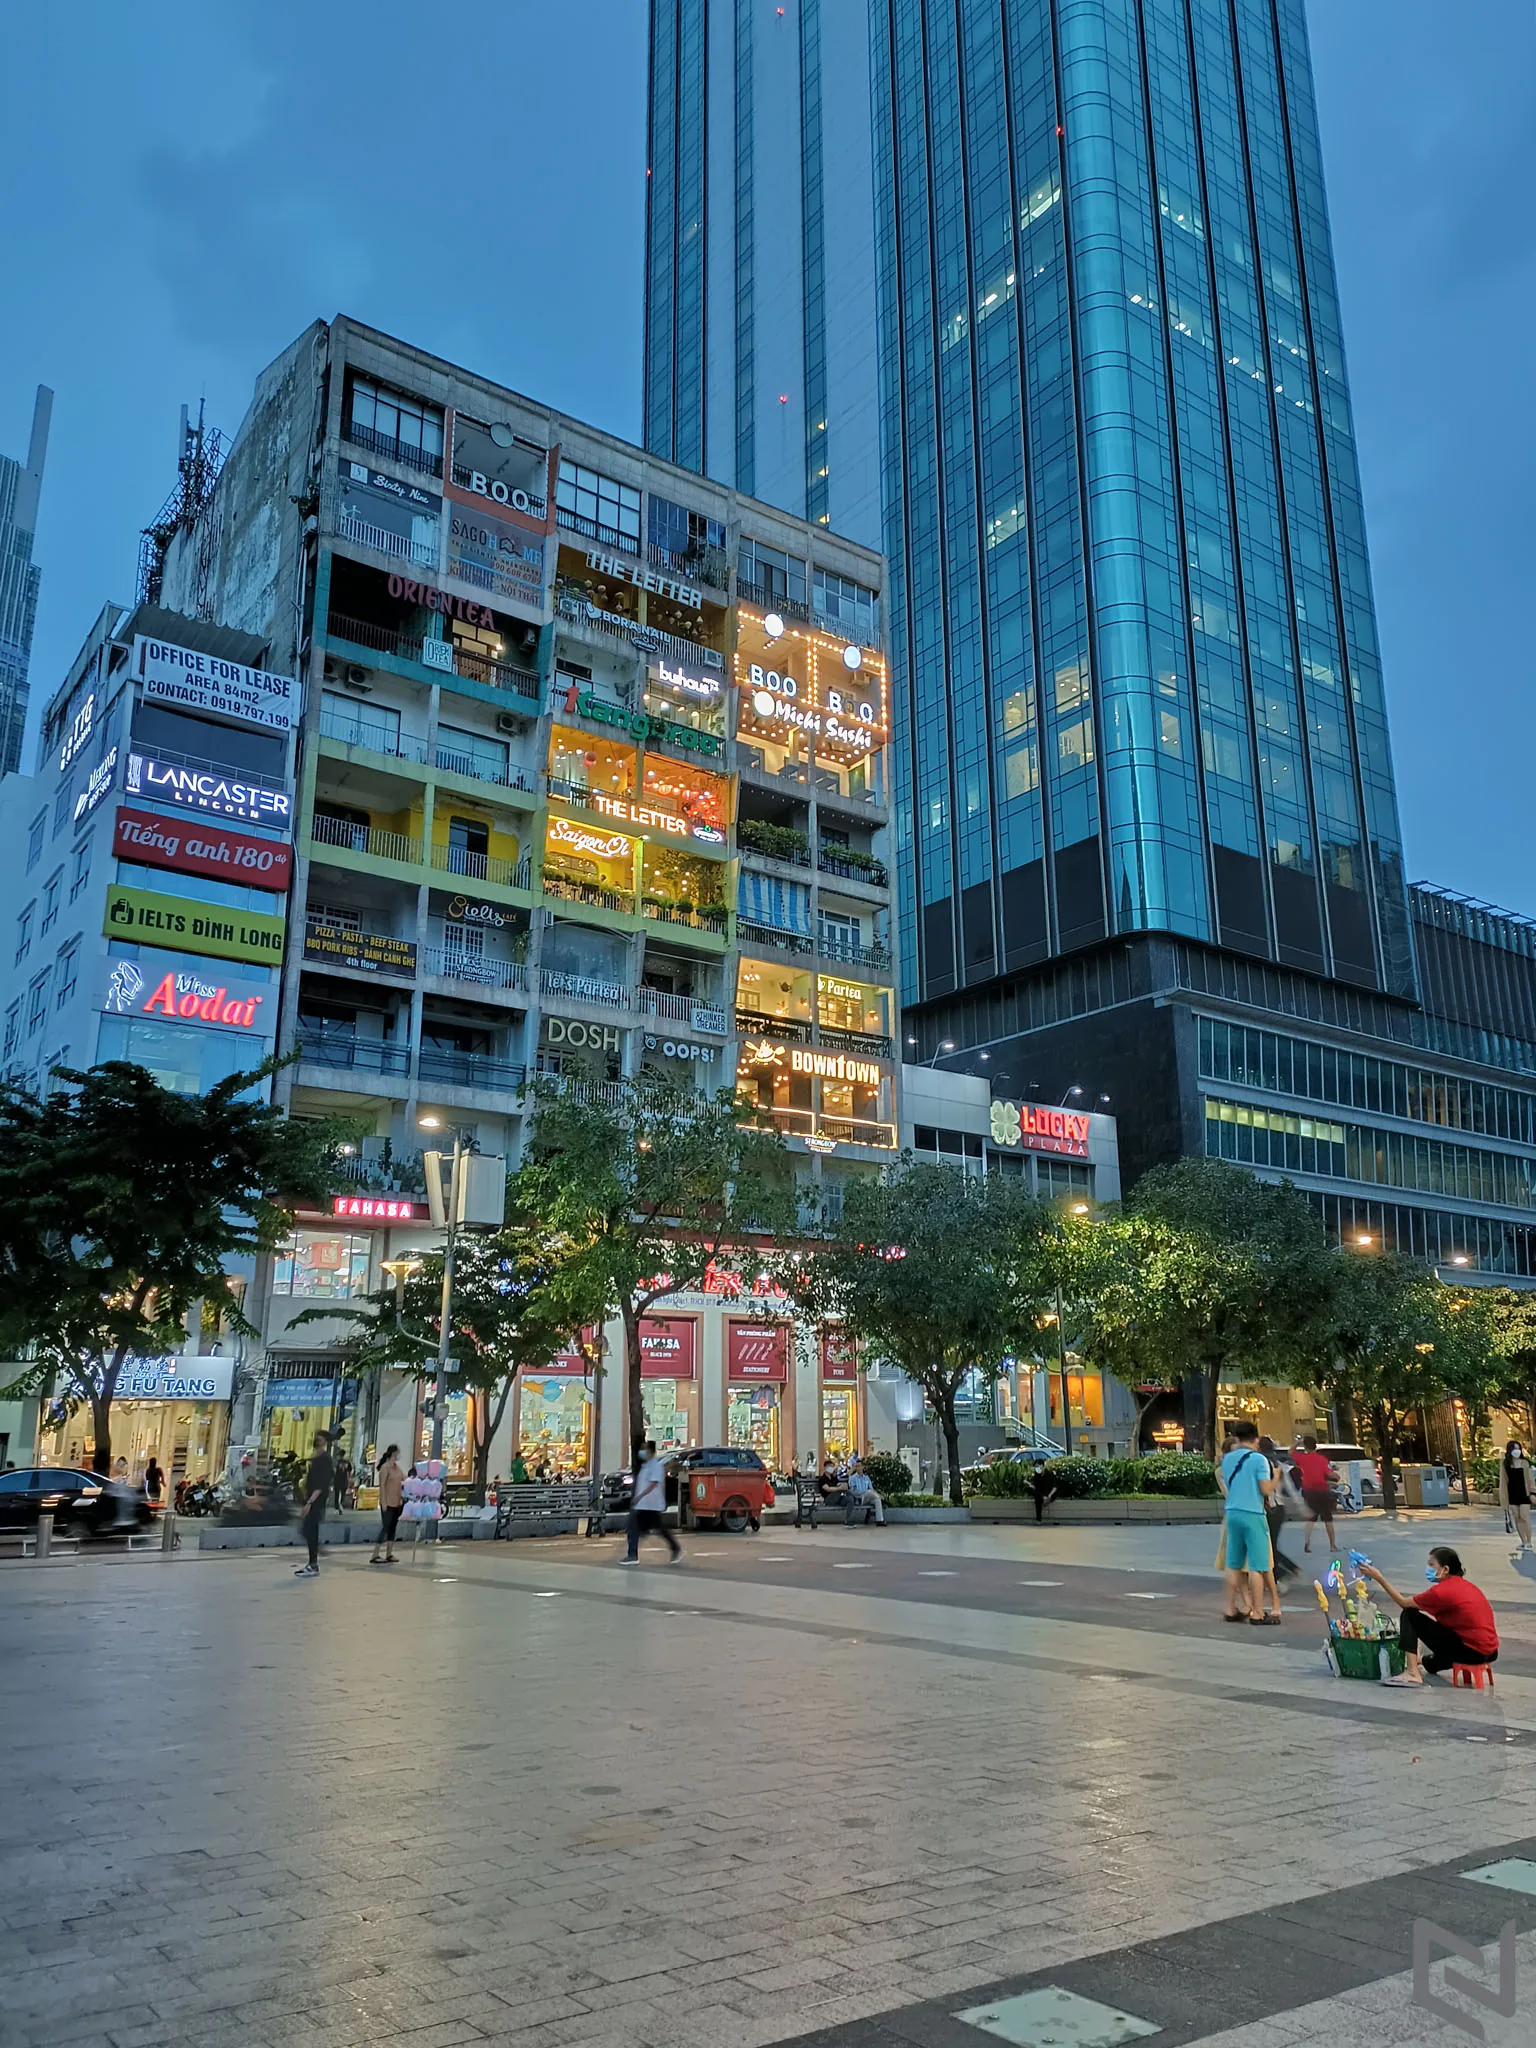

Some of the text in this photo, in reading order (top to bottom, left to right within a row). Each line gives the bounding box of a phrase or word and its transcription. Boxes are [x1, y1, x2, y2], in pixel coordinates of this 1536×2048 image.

[373, 475, 429, 505] Sixty Nine
[472, 471, 528, 511] BOO
[587, 549, 702, 610] THE LETTER
[388, 574, 495, 630] ORIENTEA
[603, 611, 638, 631] BORA
[149, 642, 291, 699] OFFICE FOR LEASE
[750, 664, 798, 698] BOO
[148, 680, 289, 729] CONTACT: 0919.797.199
[185, 672, 260, 705] AREA 84m2
[829, 692, 874, 724] BOO
[775, 700, 873, 750] Michi Sushi
[147, 761, 289, 815] LANCASTER
[174, 792, 260, 819] LINCOLN
[596, 795, 626, 820] THE
[630, 806, 688, 836] LETTER
[118, 820, 181, 856] Tiếng
[186, 839, 229, 864] anh
[234, 846, 274, 872] 180
[549, 820, 605, 856] Saigon
[139, 907, 282, 950] IELTS ĐÌNH LONG
[315, 926, 409, 953] PIZZA PASTA BEEF STEAK
[306, 938, 321, 950] BBQ
[322, 941, 341, 953] PORK
[342, 945, 358, 957] RIBS
[383, 953, 401, 965] CANH
[345, 956, 378, 971] 4th floor
[175, 973, 217, 998] Miss
[456, 964, 498, 979] STRONGBOW
[827, 979, 862, 1001] Partea
[548, 1017, 620, 1053] DOSH
[697, 1020, 726, 1033] DREAMER
[701, 1012, 726, 1026] THINKER
[663, 1041, 715, 1064] OOPS!
[1022, 1105, 1091, 1143] LUCKY
[1027, 1136, 1087, 1156] PLAZA
[338, 1200, 411, 1218] FAHASA
[132, 1378, 158, 1393] FU
[163, 1378, 216, 1393] TANG
